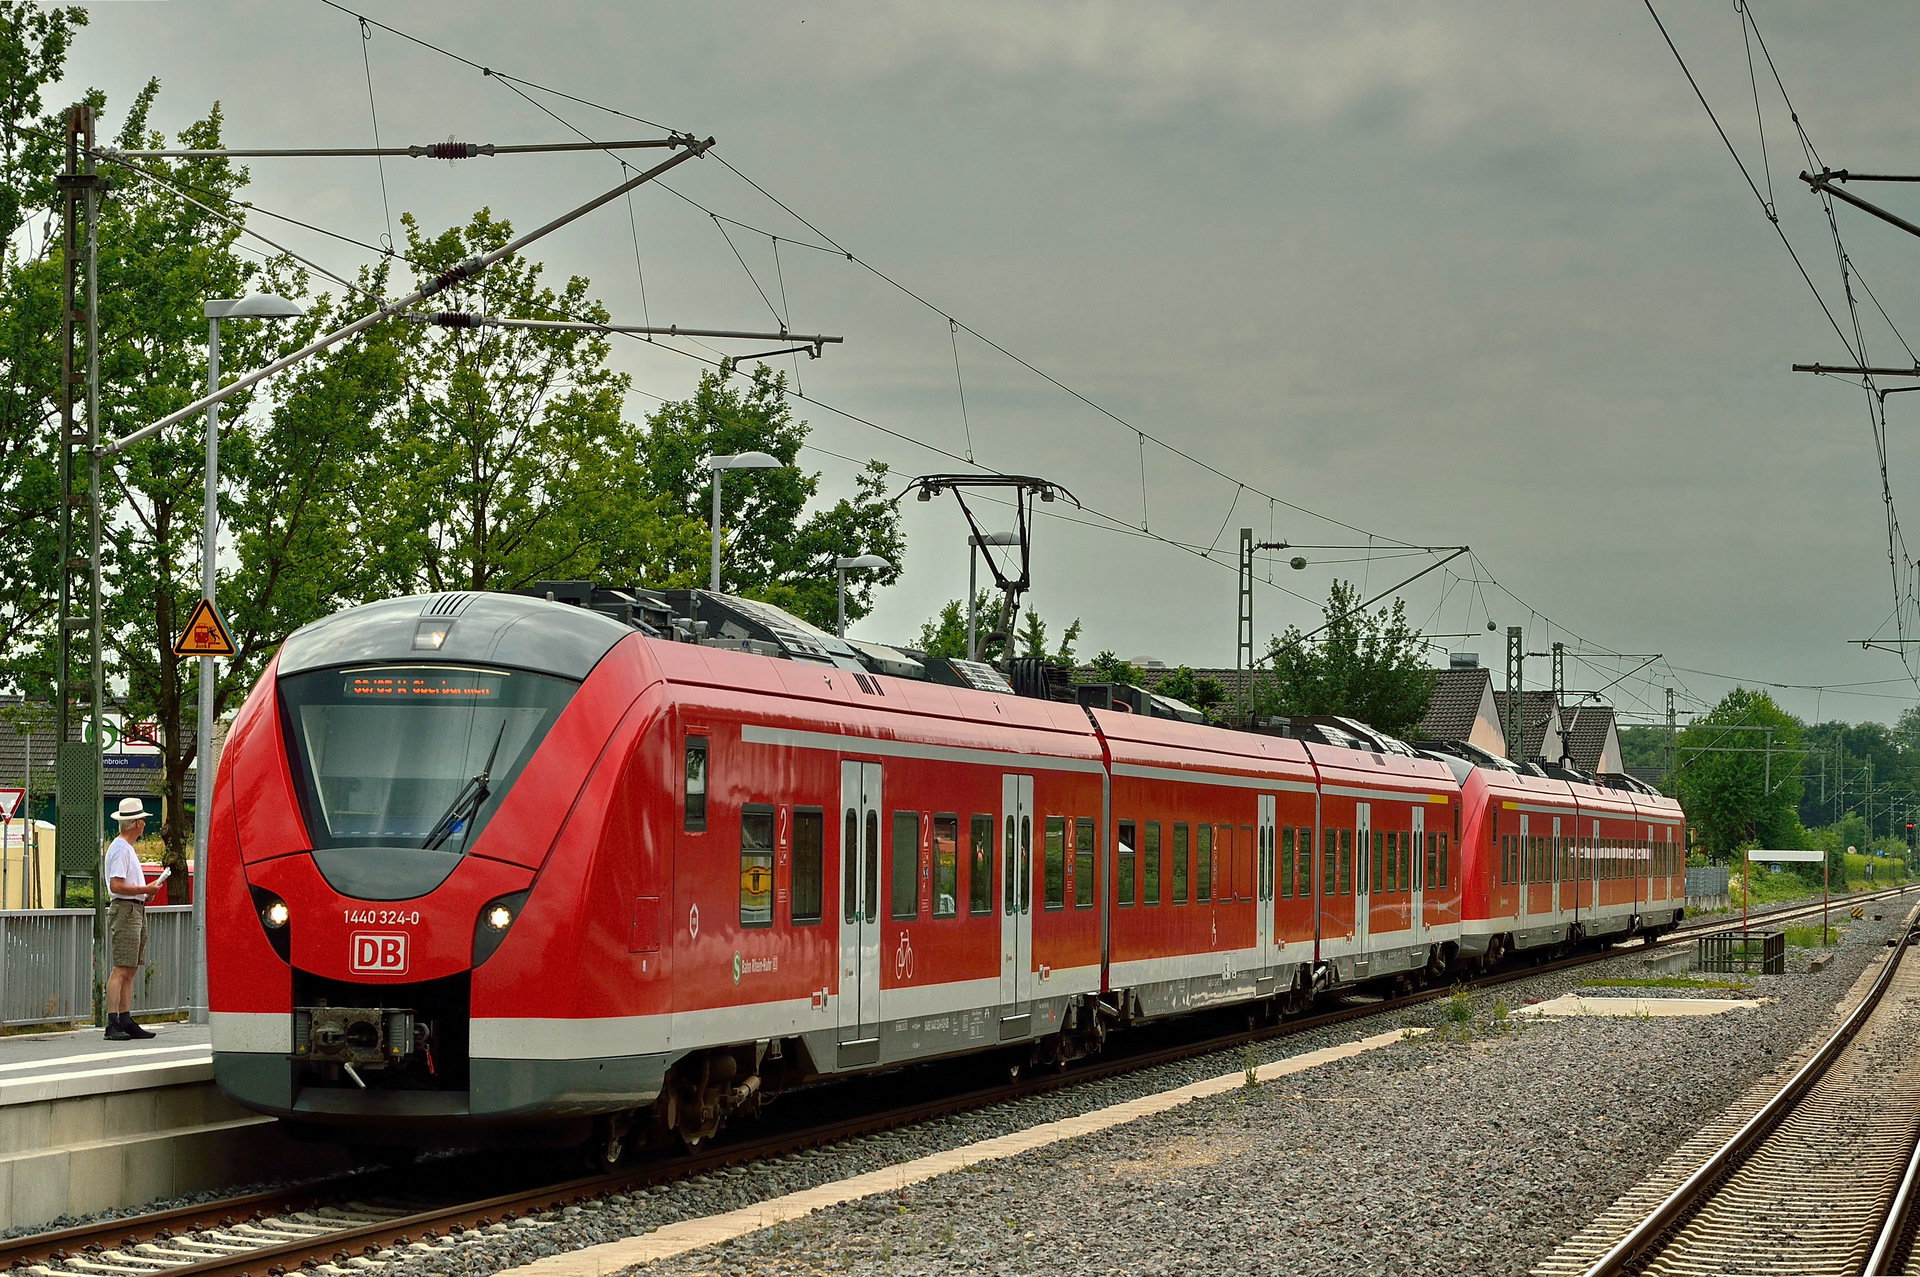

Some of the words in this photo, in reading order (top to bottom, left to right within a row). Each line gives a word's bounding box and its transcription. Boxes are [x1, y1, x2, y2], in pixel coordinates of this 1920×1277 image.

[780, 807, 787, 845] 2
[923, 814, 929, 847] 2
[344, 910, 376, 924] 1440
[380, 910, 420, 925] 324-0
[358, 938, 402, 967] DB
[734, 953, 740, 982] S
